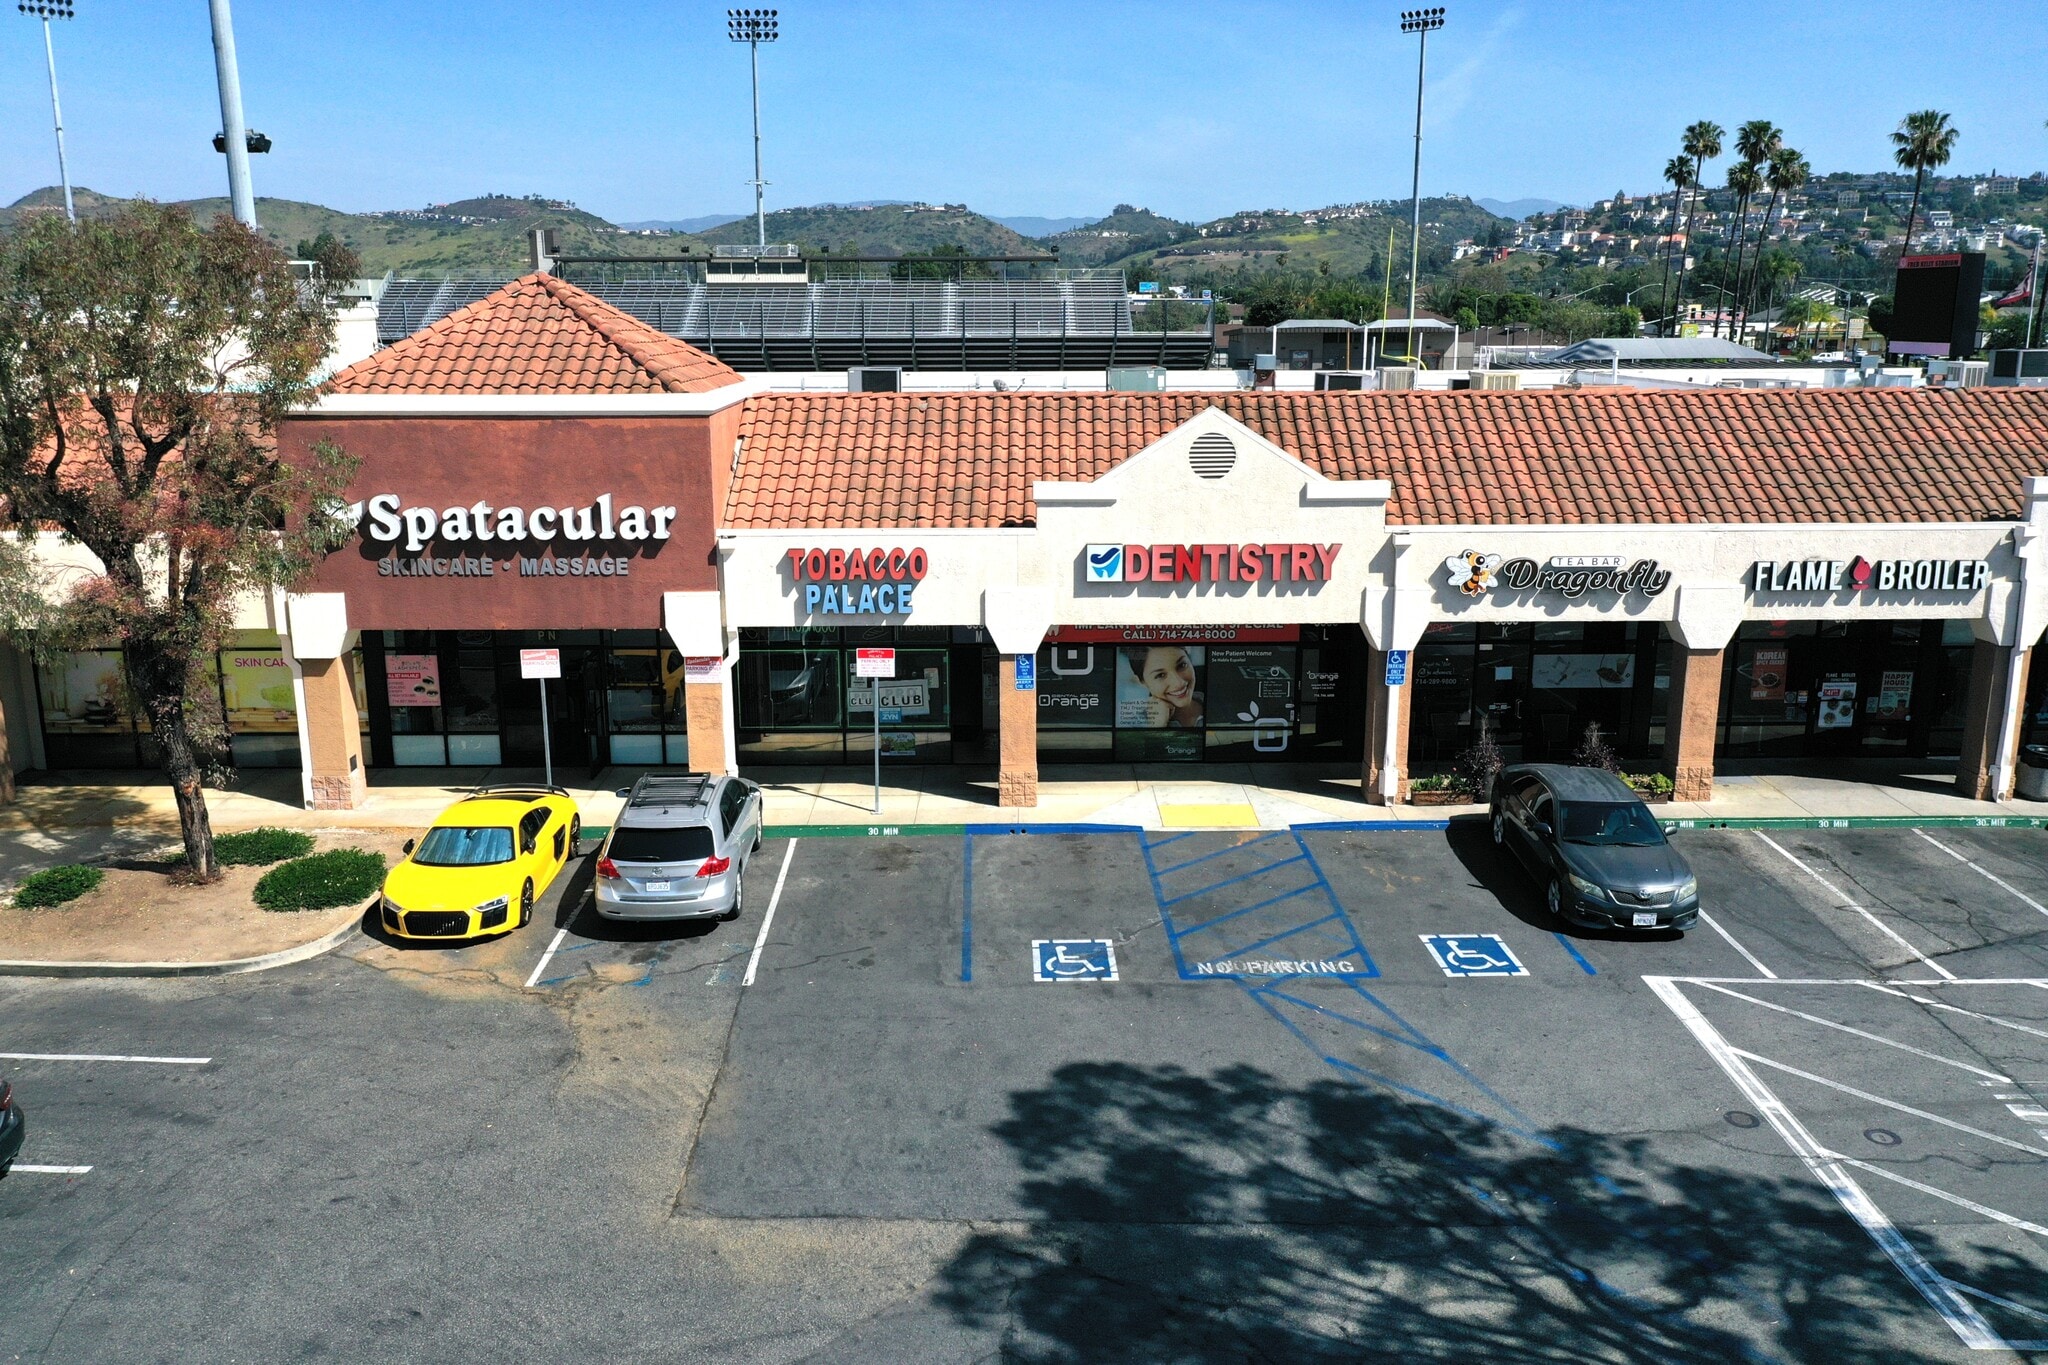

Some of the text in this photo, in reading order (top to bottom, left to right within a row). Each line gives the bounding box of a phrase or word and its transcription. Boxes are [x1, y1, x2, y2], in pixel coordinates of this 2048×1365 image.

[368, 492, 677, 552] Spatacular
[378, 558, 629, 576] SKINCARE MASSAGE
[788, 547, 928, 581] TOBACCO
[1124, 544, 1342, 582] DENTISTRY
[1557, 558, 1621, 566] TEA BAR
[1503, 557, 1672, 598] Dragonfly
[1753, 560, 1990, 590] FLAME BROILER
[805, 583, 914, 614] PALACE
[1160, 630, 1236, 640] 714-744-6000
[1502, 626, 1508, 638] K
[234, 658, 288, 668] SKIN CAR
[881, 695, 921, 706] CLUB
[1039, 694, 1099, 710] Orange
[1680, 820, 1695, 828] MIN
[1833, 819, 1848, 828] MIN
[1991, 818, 2006, 826] MIN
[1247, 961, 1354, 974] PARKING
